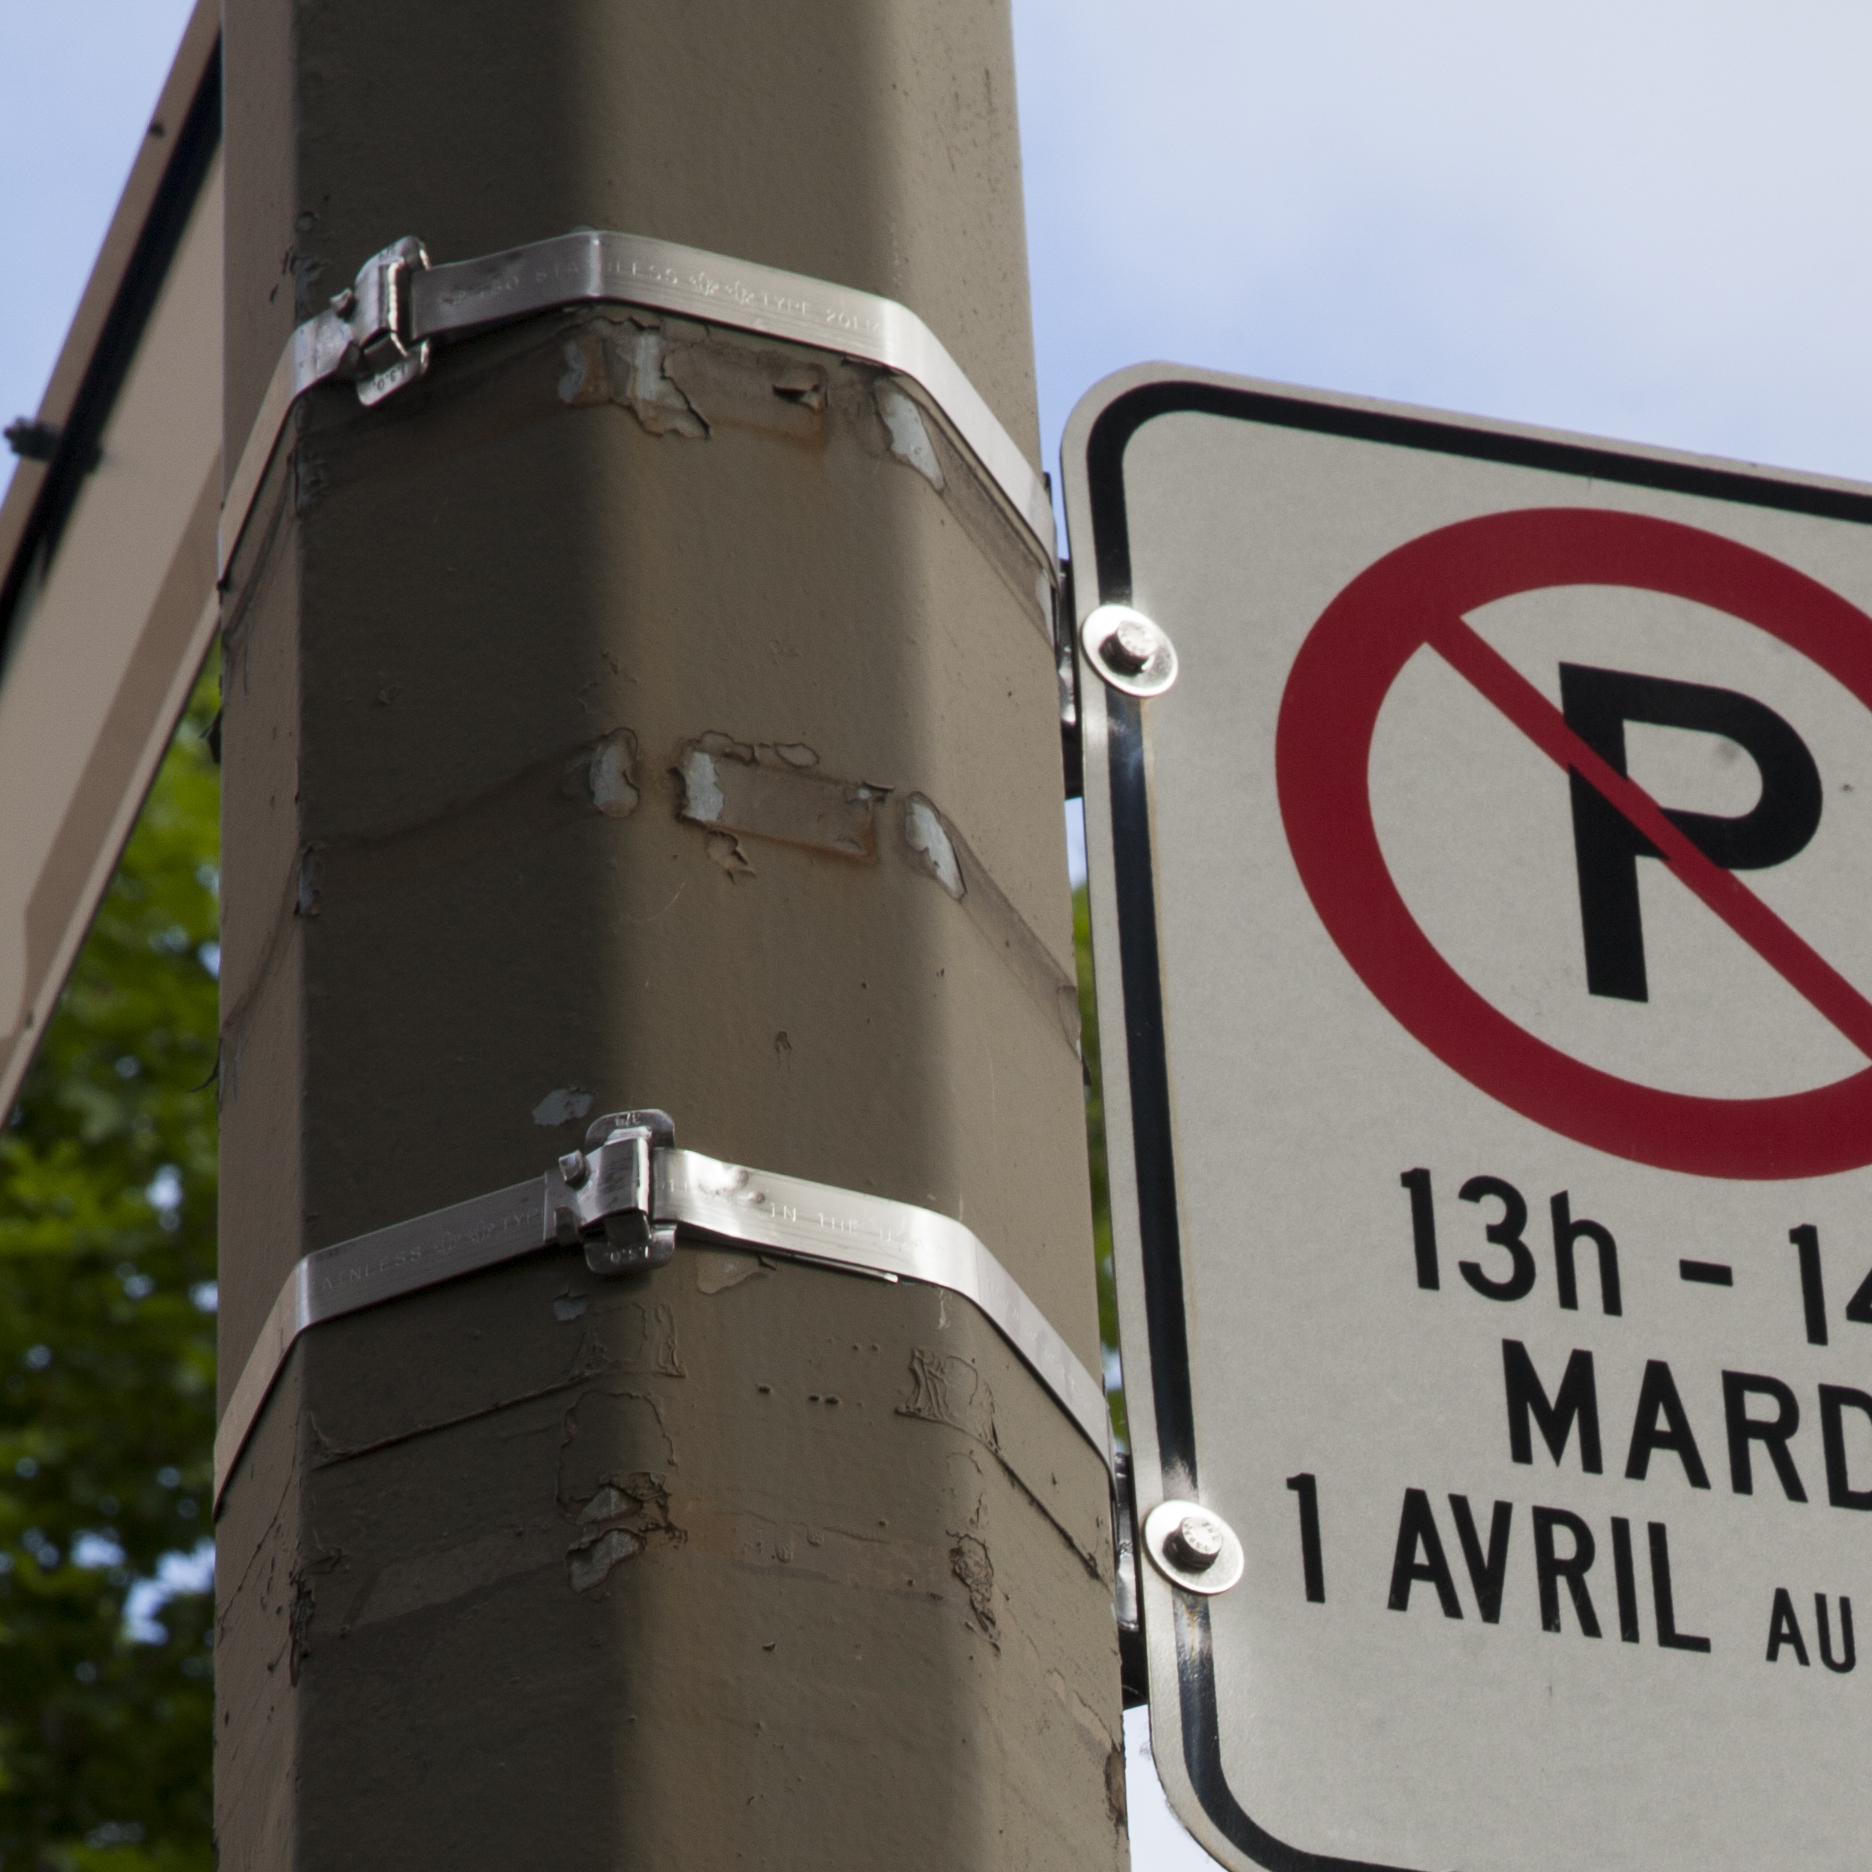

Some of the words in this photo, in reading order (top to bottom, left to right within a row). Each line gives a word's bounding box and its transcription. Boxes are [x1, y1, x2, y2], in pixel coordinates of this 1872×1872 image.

[1559, 661, 1824, 1002] P
[1399, 1167, 1623, 1318] 13h
[1285, 1472, 1326, 1605] 1
[1386, 1487, 1712, 1654] AVRIL
[1765, 1587, 1857, 1674] AU
